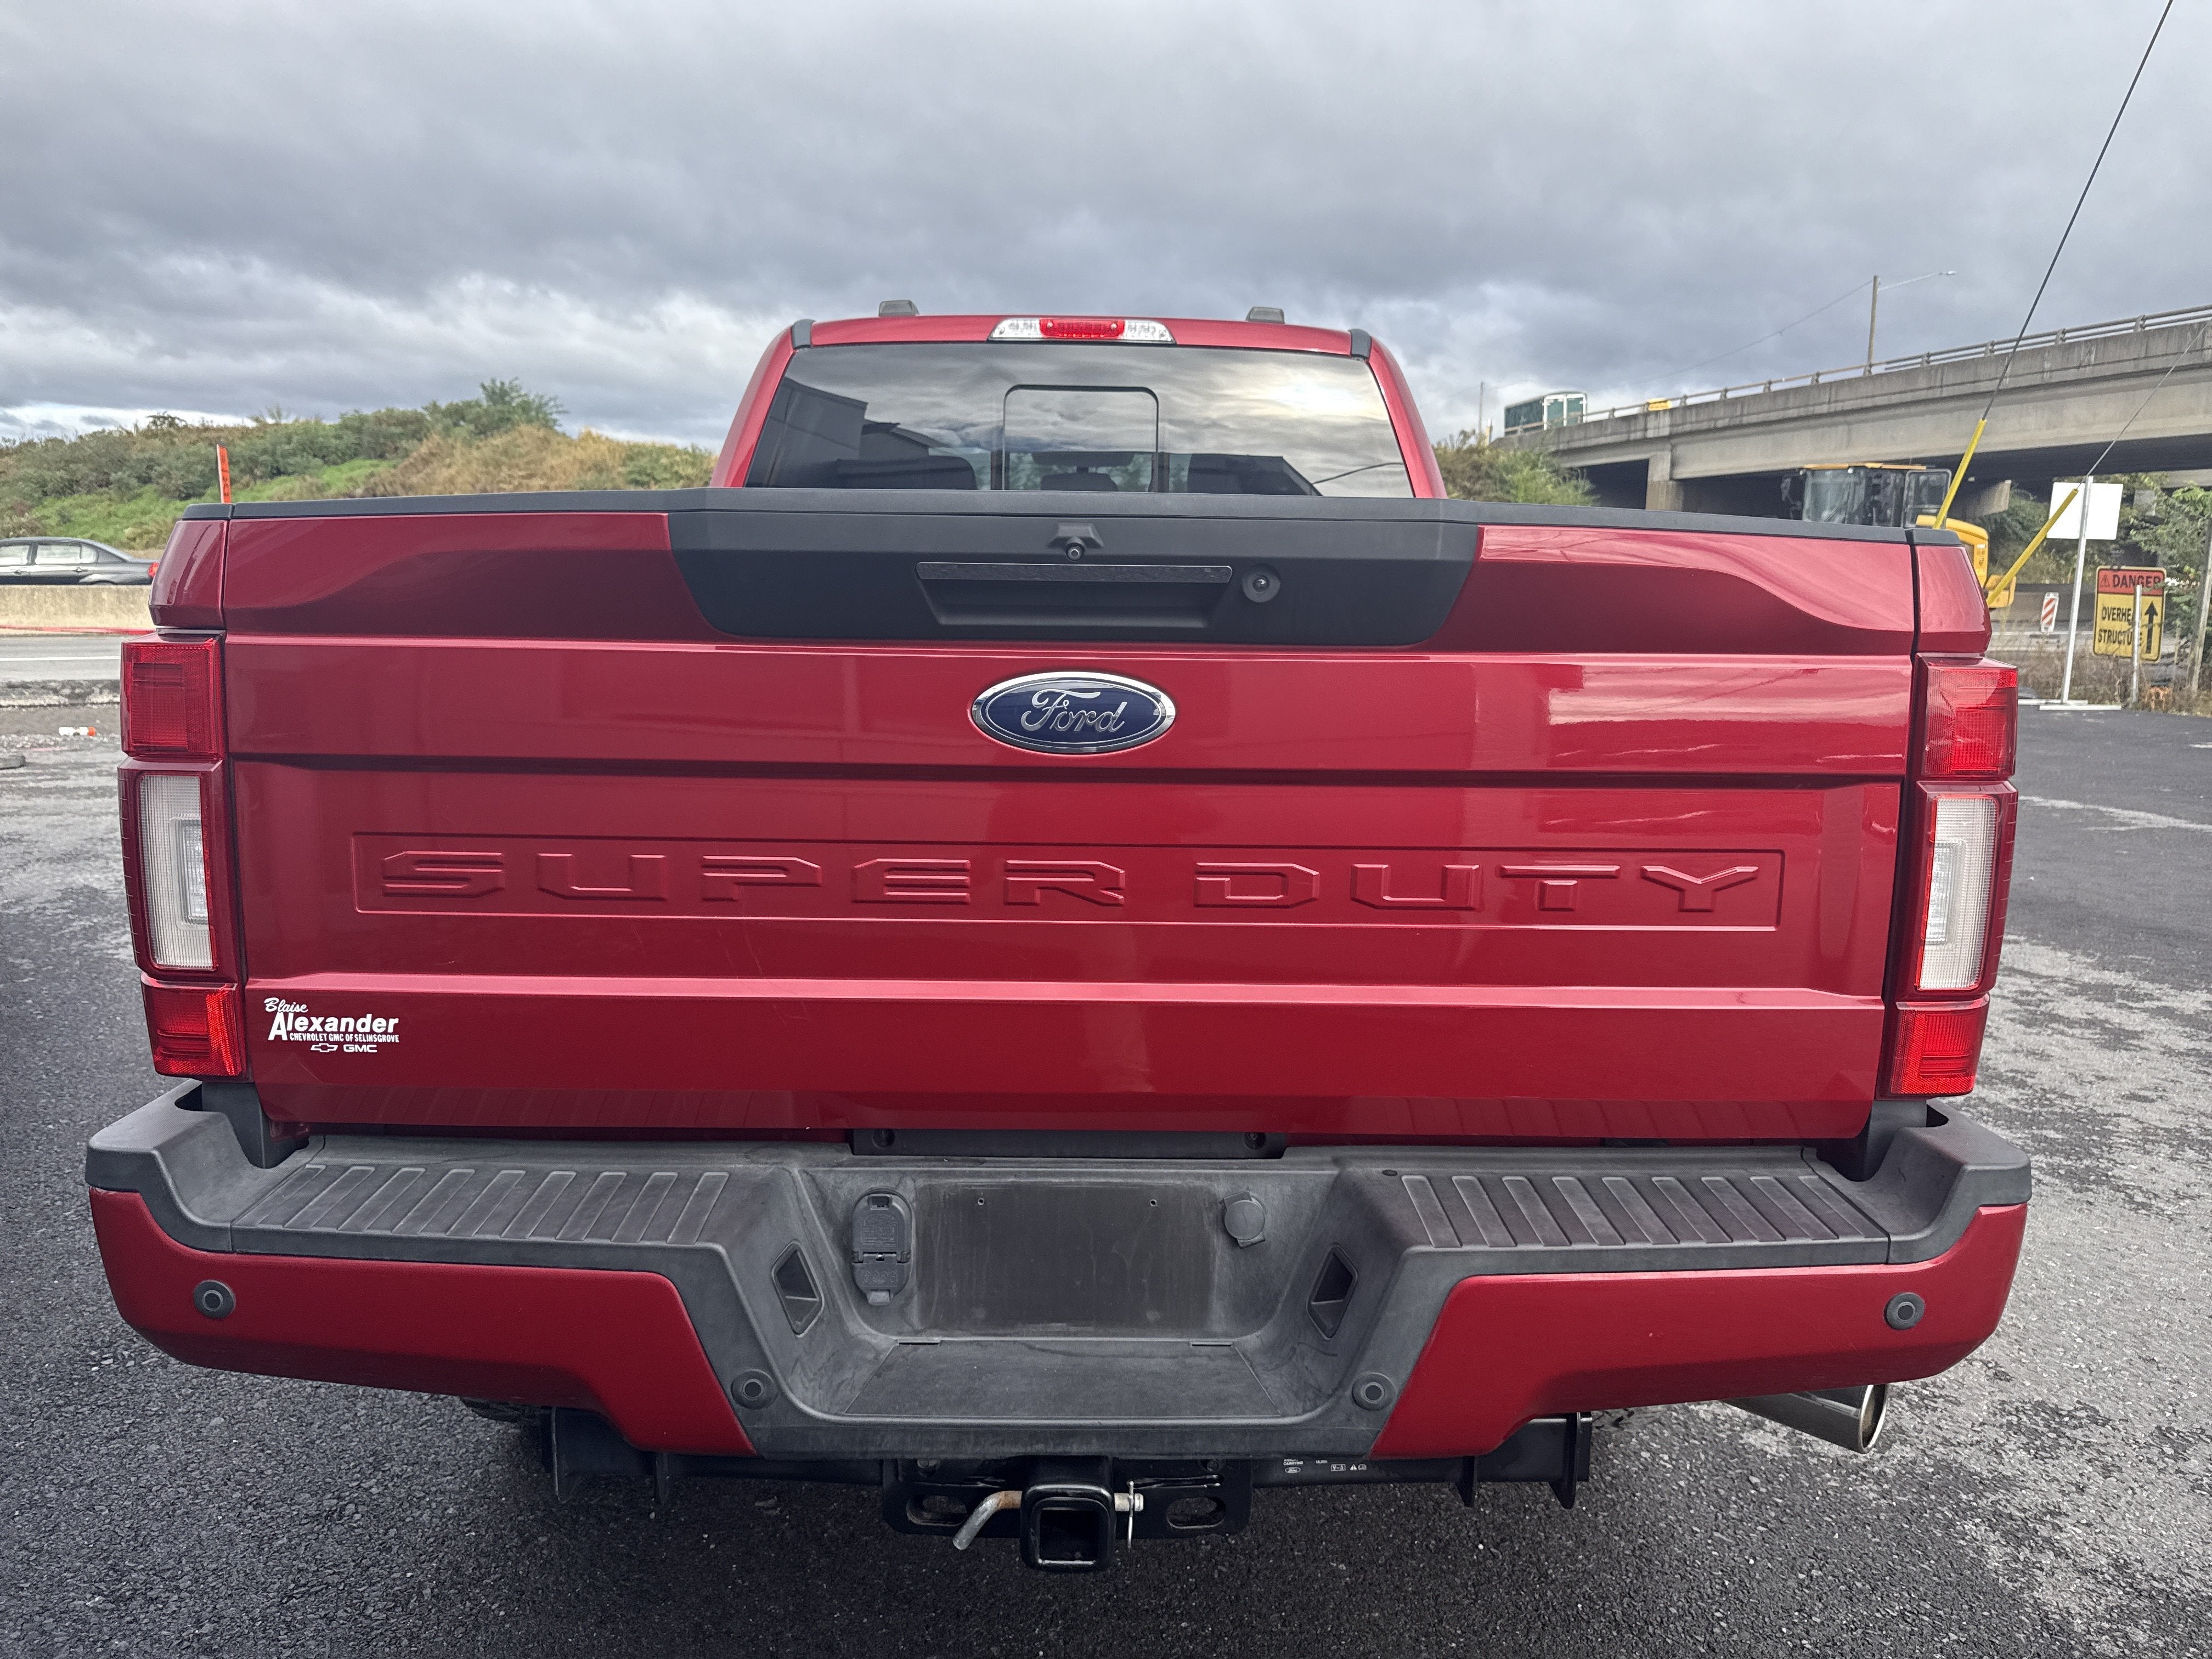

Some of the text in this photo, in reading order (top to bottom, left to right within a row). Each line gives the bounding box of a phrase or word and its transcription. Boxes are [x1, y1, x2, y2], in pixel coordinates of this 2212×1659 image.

[2113, 574, 2162, 589] DANGER
[2102, 606, 2134, 622] OVERHE
[2098, 629, 2142, 646] STRUCTUE
[1020, 689, 1127, 733] Ford
[381, 850, 1760, 914] SUPER DUTY
[264, 997, 309, 1013] Blaise
[268, 1012, 399, 1041] Alexander
[289, 1032, 400, 1043] CHEVROLET GMC OF SELINSGROVE
[343, 1044, 378, 1053] GMC
